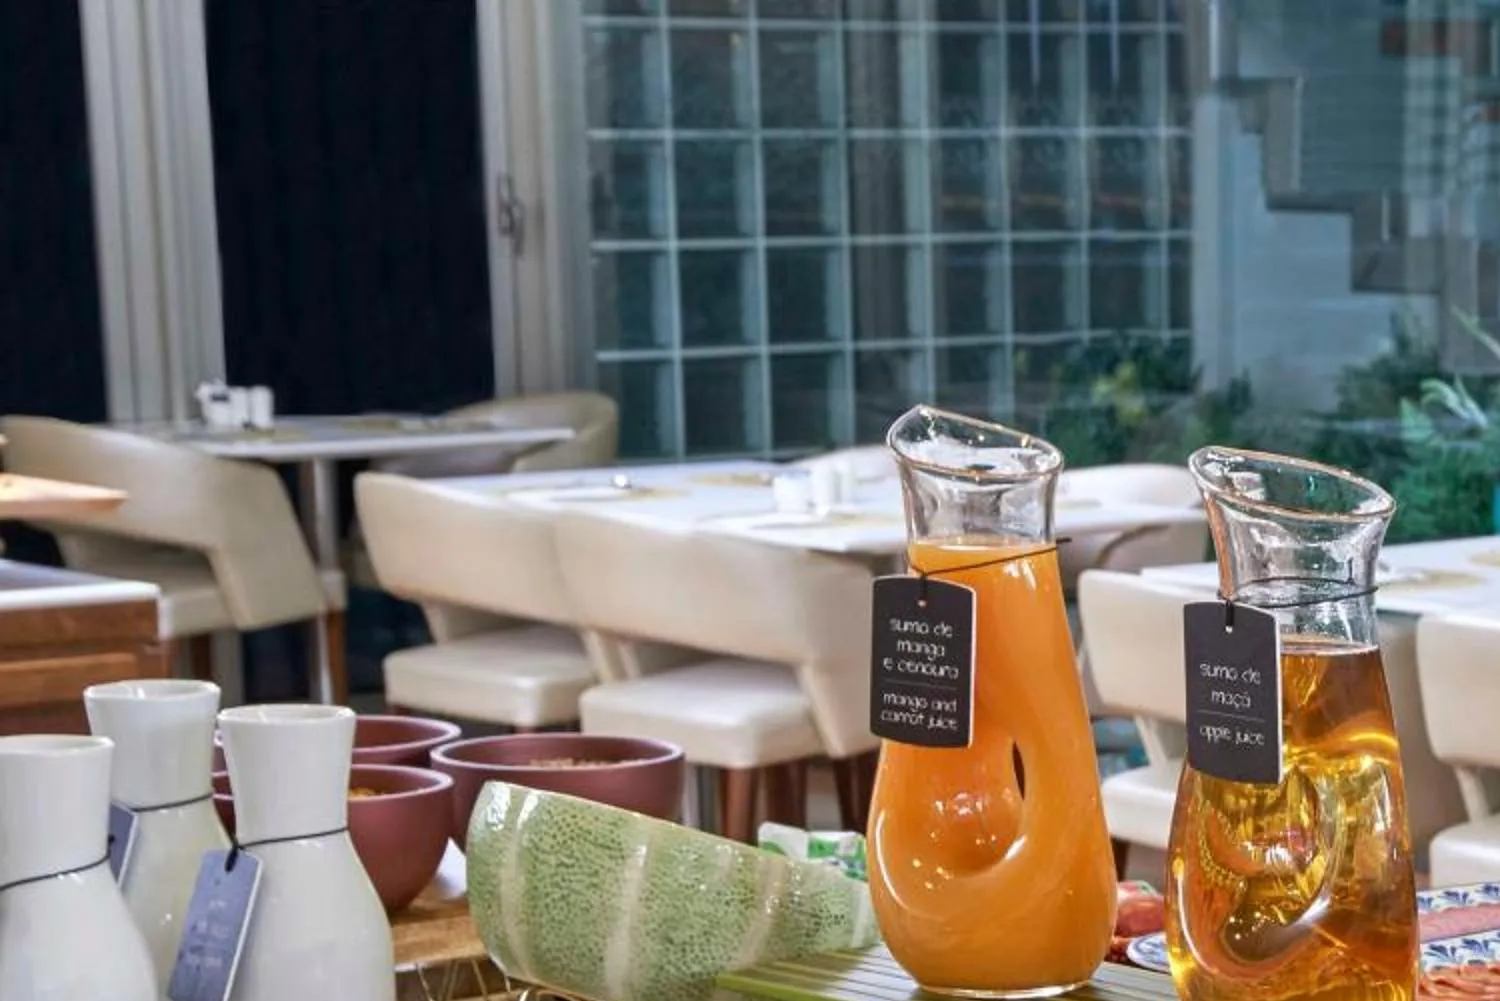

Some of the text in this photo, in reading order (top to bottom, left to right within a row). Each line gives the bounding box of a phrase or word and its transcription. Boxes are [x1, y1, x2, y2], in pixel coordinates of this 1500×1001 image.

[889, 618, 953, 638] sumo de
[896, 640, 945, 661] manga
[883, 657, 959, 680] e cenoura
[1199, 663, 1261, 685] sumo de
[883, 693, 957, 713] mango and
[881, 709, 957, 731] carrot juice
[1235, 728, 1265, 746] juice
